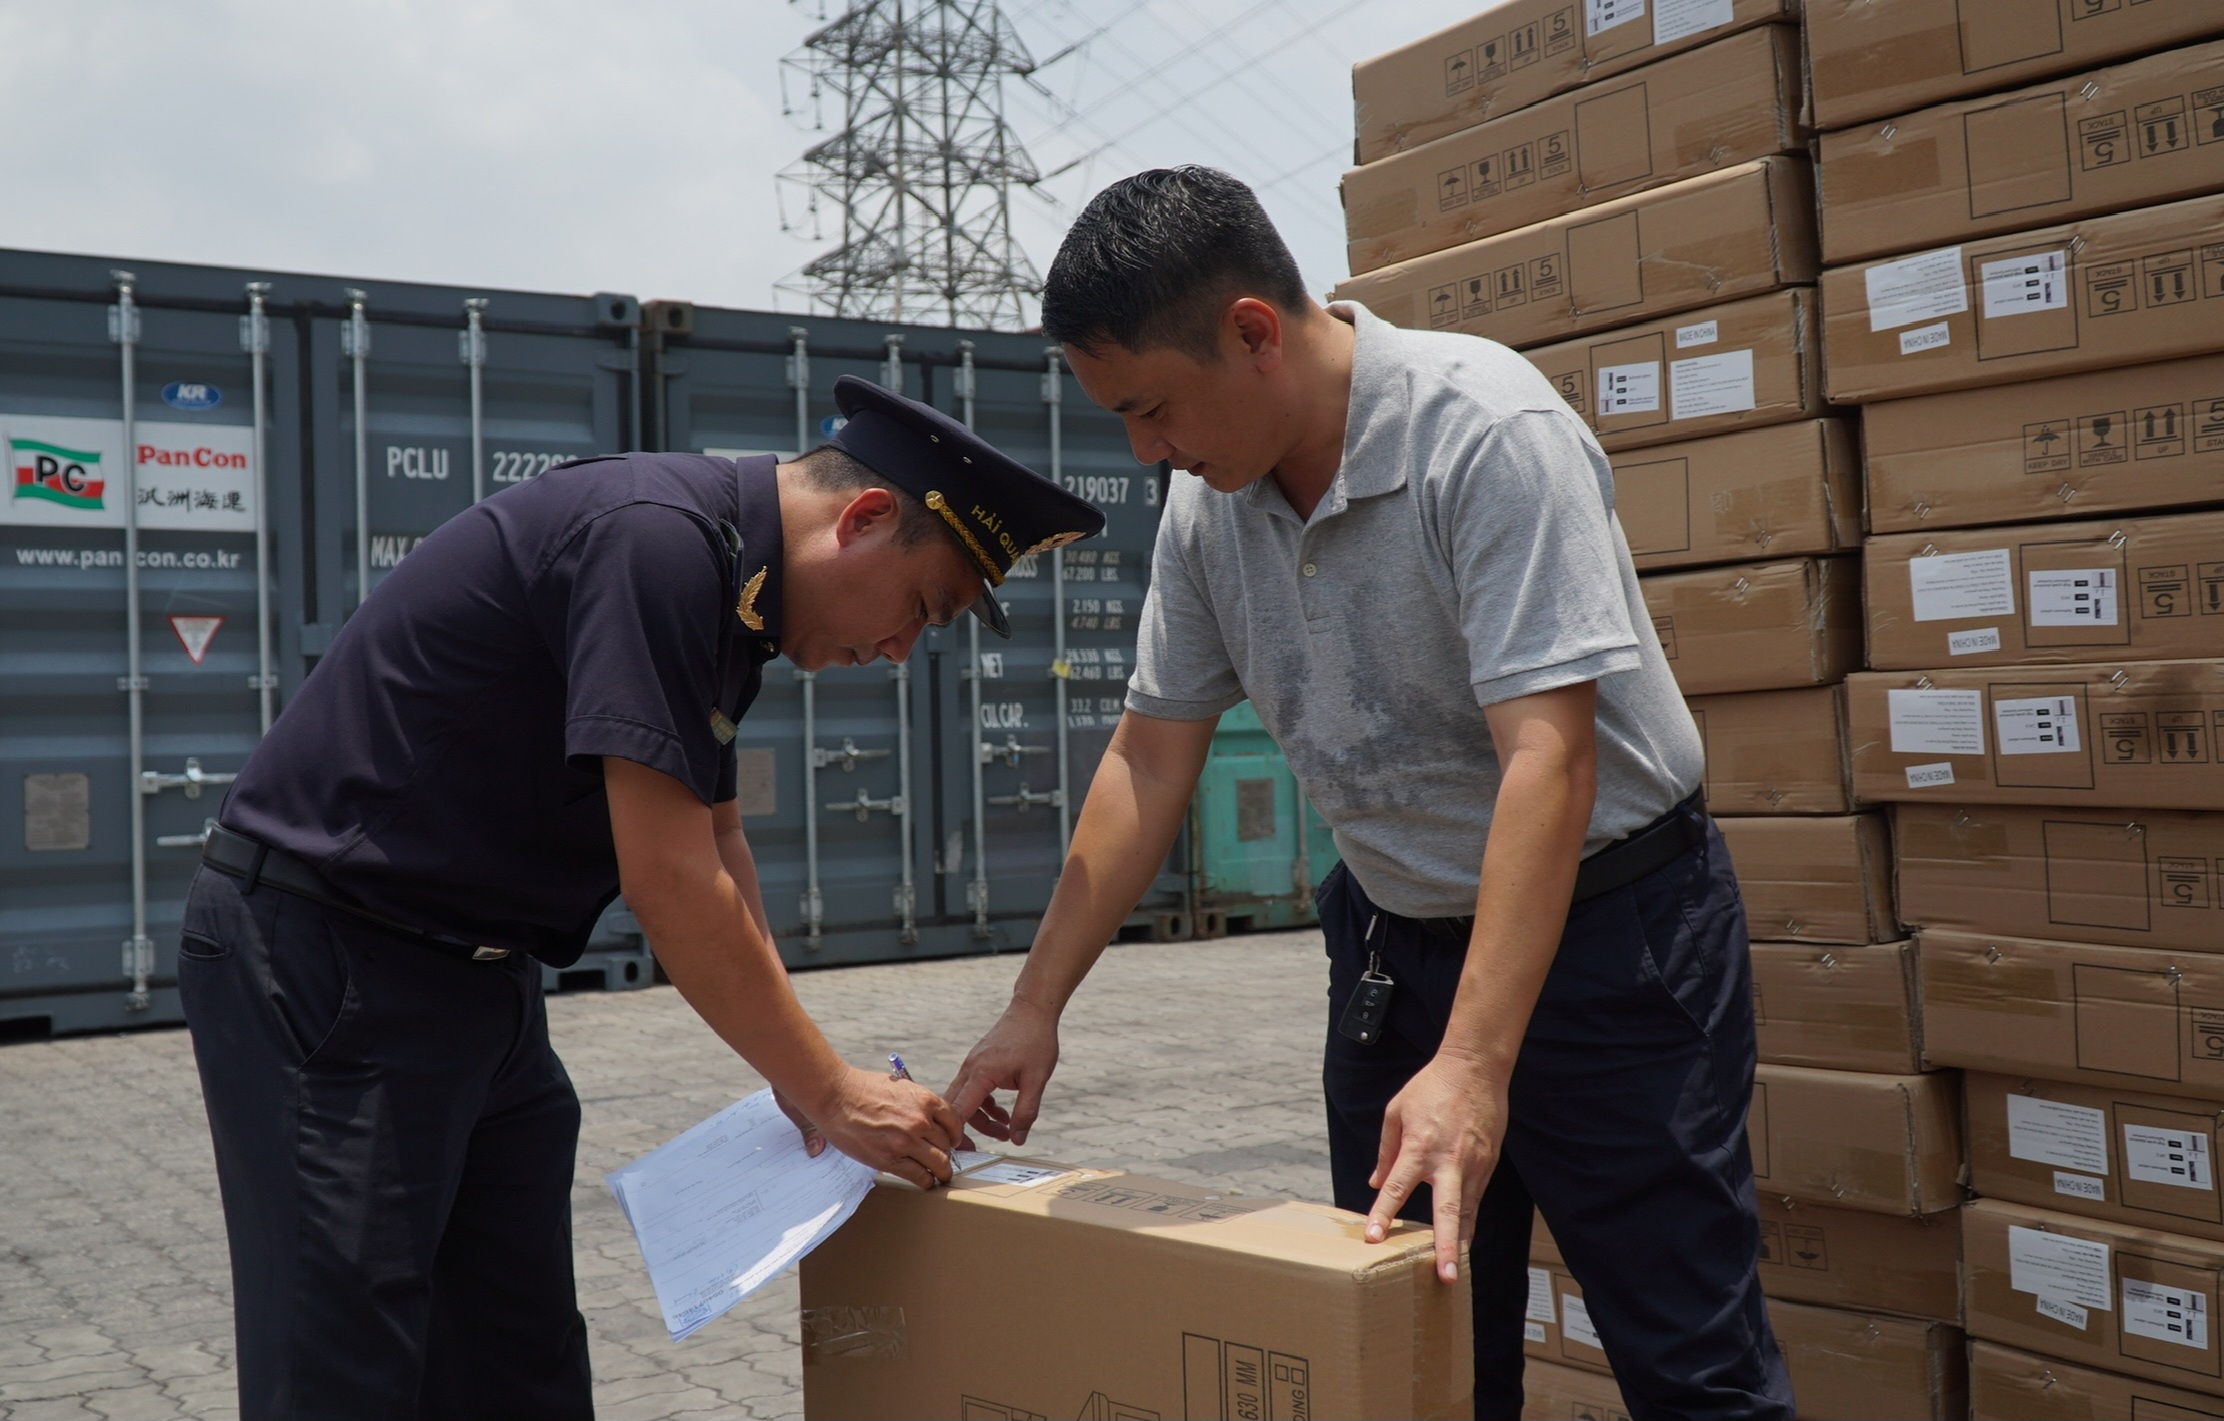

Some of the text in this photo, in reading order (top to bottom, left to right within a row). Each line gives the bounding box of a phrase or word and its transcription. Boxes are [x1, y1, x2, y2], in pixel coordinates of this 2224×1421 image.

[2084, 0, 2104, 14] 5
[1553, 12, 1566, 32] 5
[1551, 41, 1569, 51] STACK
[2149, 105, 2162, 115] UP
[2087, 118, 2114, 130] STACK
[1548, 135, 1561, 155] 5
[2094, 141, 2115, 165] 5
[1548, 165, 1565, 175] STACK
[1539, 258, 1552, 277] 5
[2095, 266, 2122, 278] STACK
[2100, 290, 2121, 312] 5
[1678, 327, 1715, 342] MADE IN CHINA
[1904, 330, 1947, 349] MADE IN CHINA
[1562, 375, 1575, 394] 5
[2157, 446, 2169, 454] UP
[2206, 440, 2224, 448] STA
[136, 444, 248, 469] PanCon
[387, 446, 578, 482] PCLU 2222
[2028, 458, 2068, 471] KEEP DRY
[35, 455, 88, 493] PC
[1064, 475, 1158, 505] 219037 3
[999, 532, 1020, 565] QUA
[2148, 569, 2176, 579] STACK
[2154, 593, 2174, 615] 5
[1952, 635, 1996, 650] MADE IN CHINA
[980, 653, 1004, 678] NET
[2109, 716, 2136, 725] STACK
[2170, 714, 2183, 724] UP
[2115, 739, 2135, 761] 5
[1909, 769, 1952, 784] MADE IN CHINA
[2173, 884, 2193, 904] 5
[2205, 1036, 2224, 1057] 5
[2057, 1178, 2101, 1195] MADE IN CHINA
[2040, 1300, 2084, 1325] MADE IN CHINA
[1235, 1360, 1258, 1387] MM
[1236, 1392, 1259, 1421] 630
